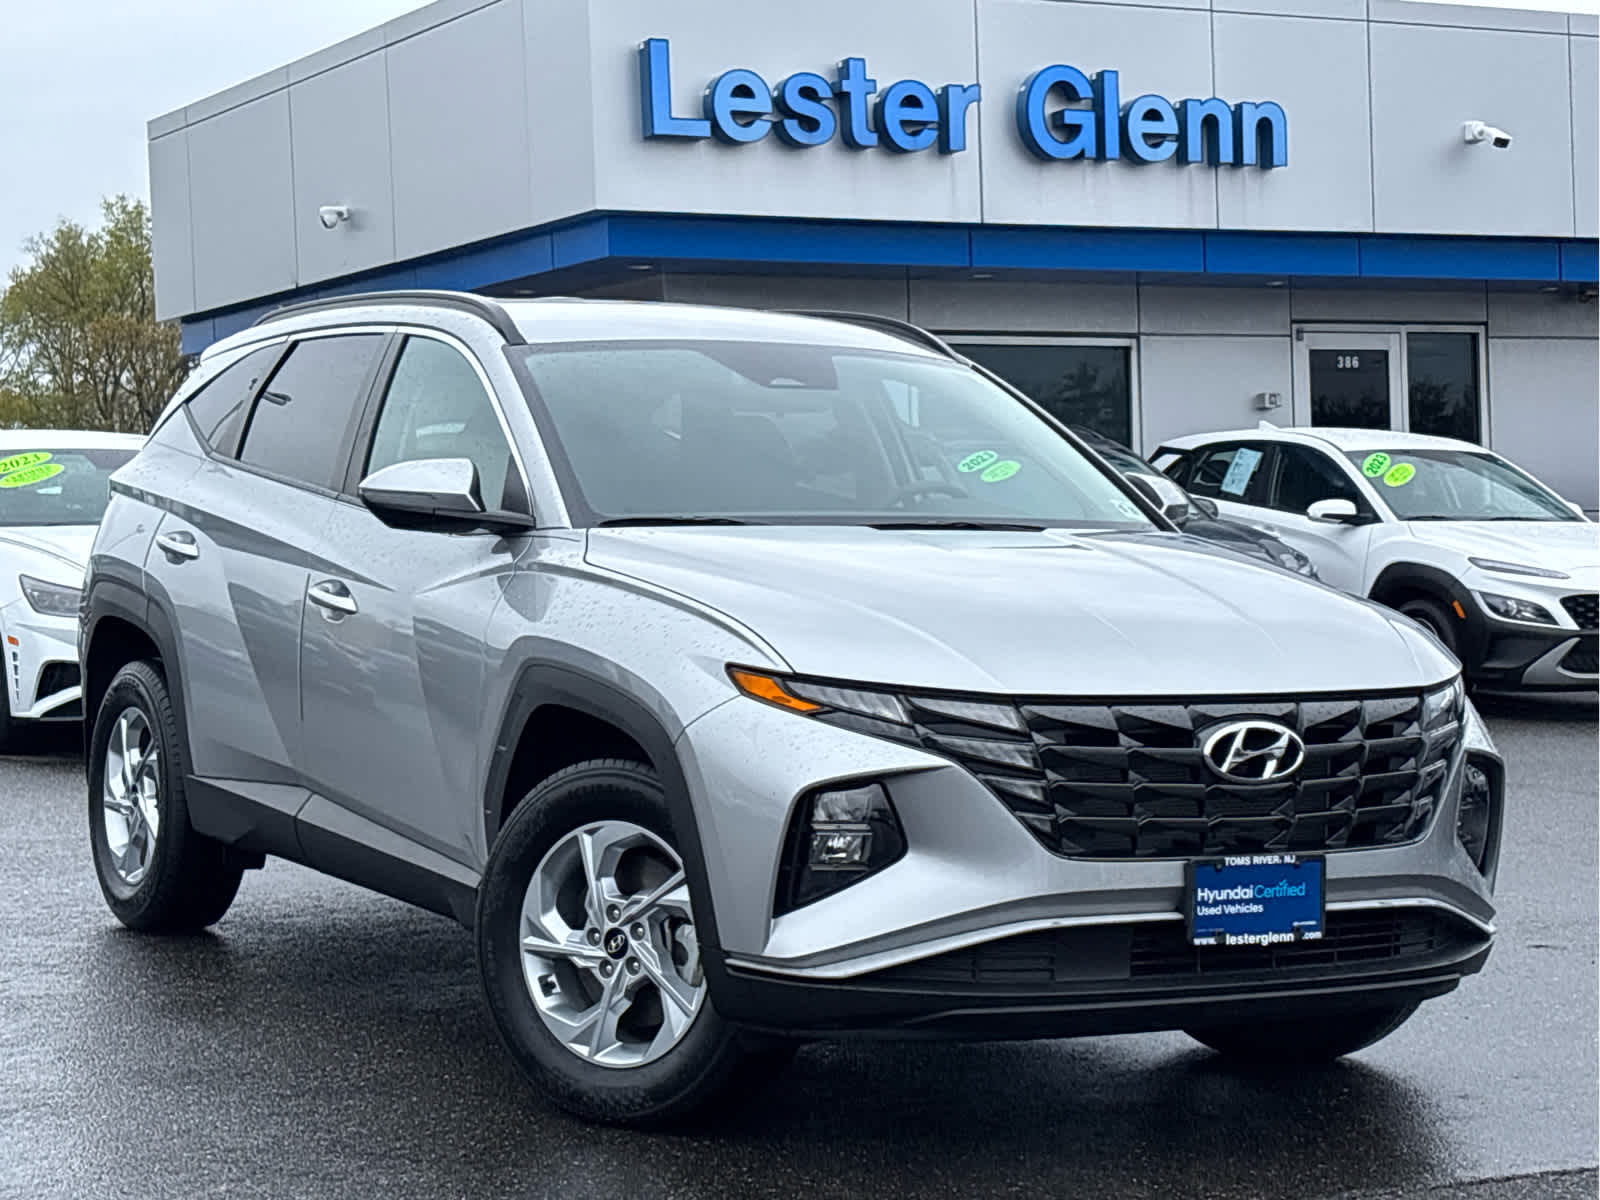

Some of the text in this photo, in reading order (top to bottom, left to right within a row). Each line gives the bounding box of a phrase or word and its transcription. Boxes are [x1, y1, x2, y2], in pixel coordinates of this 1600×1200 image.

[640, 37, 1289, 169] Lester Glenn
[1336, 355, 1360, 369] 386
[1366, 454, 1388, 475] 2023
[1224, 856, 1250, 866] TOMS
[1284, 854, 1296, 864] NJ
[1197, 881, 1306, 904] Hyundai Certified
[1196, 904, 1264, 916] Used Vehicles
[1225, 932, 1295, 946] lesterglenn
